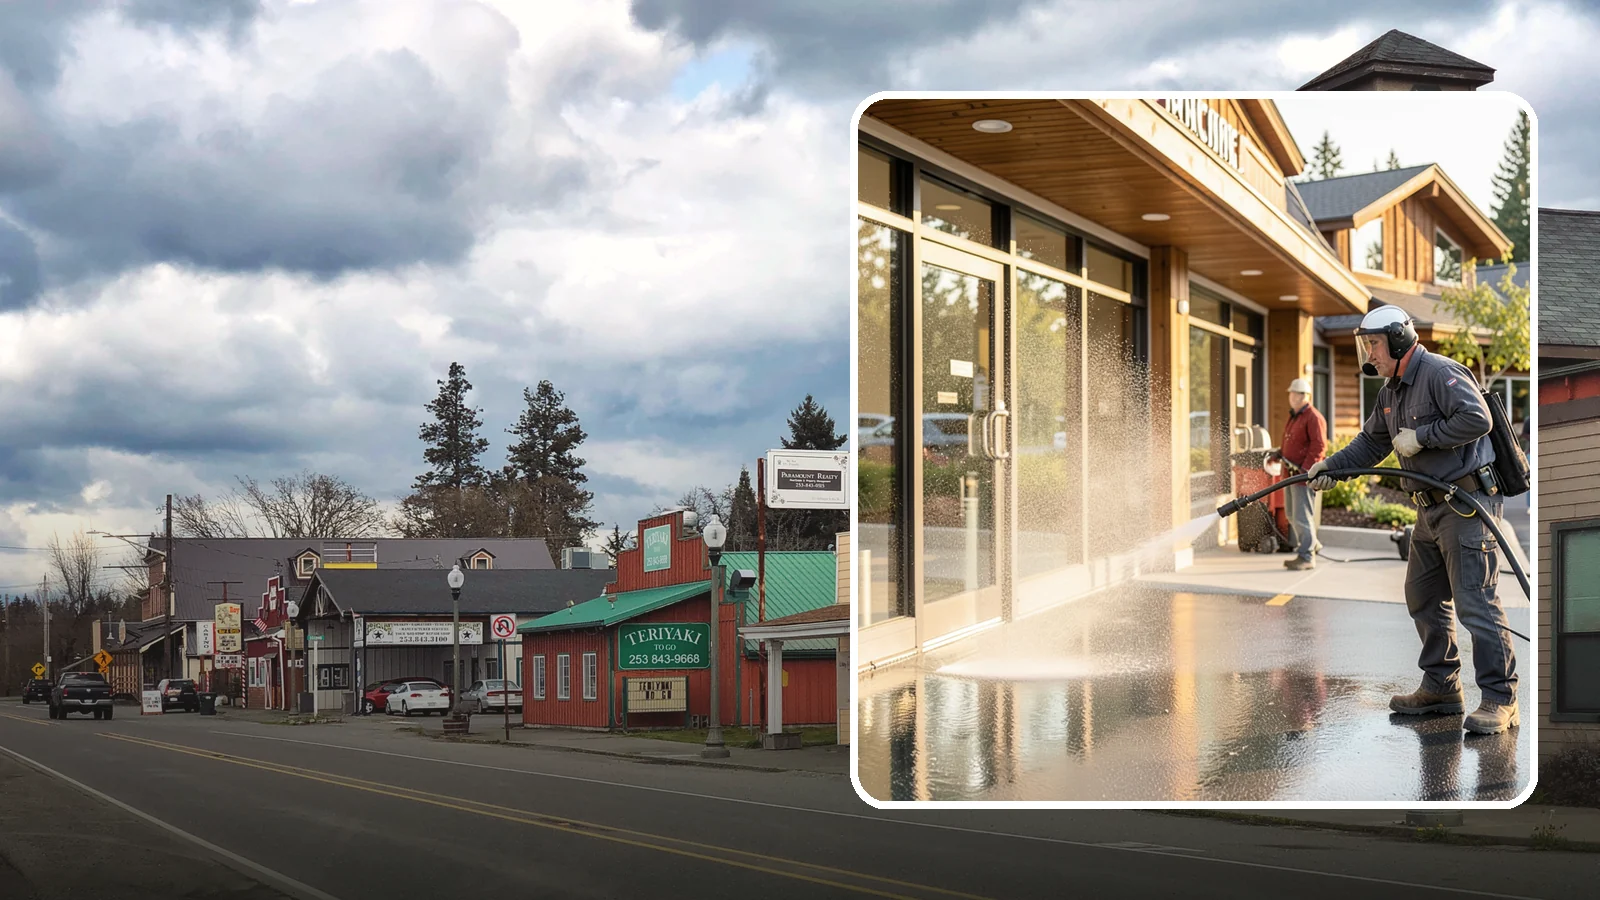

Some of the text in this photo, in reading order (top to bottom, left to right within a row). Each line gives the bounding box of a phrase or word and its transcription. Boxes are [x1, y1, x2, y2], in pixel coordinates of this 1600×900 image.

[625, 627, 701, 646] TERIYAKI
[629, 653, 700, 665] 253 843-9668
[639, 681, 672, 690] TERIYAKI
